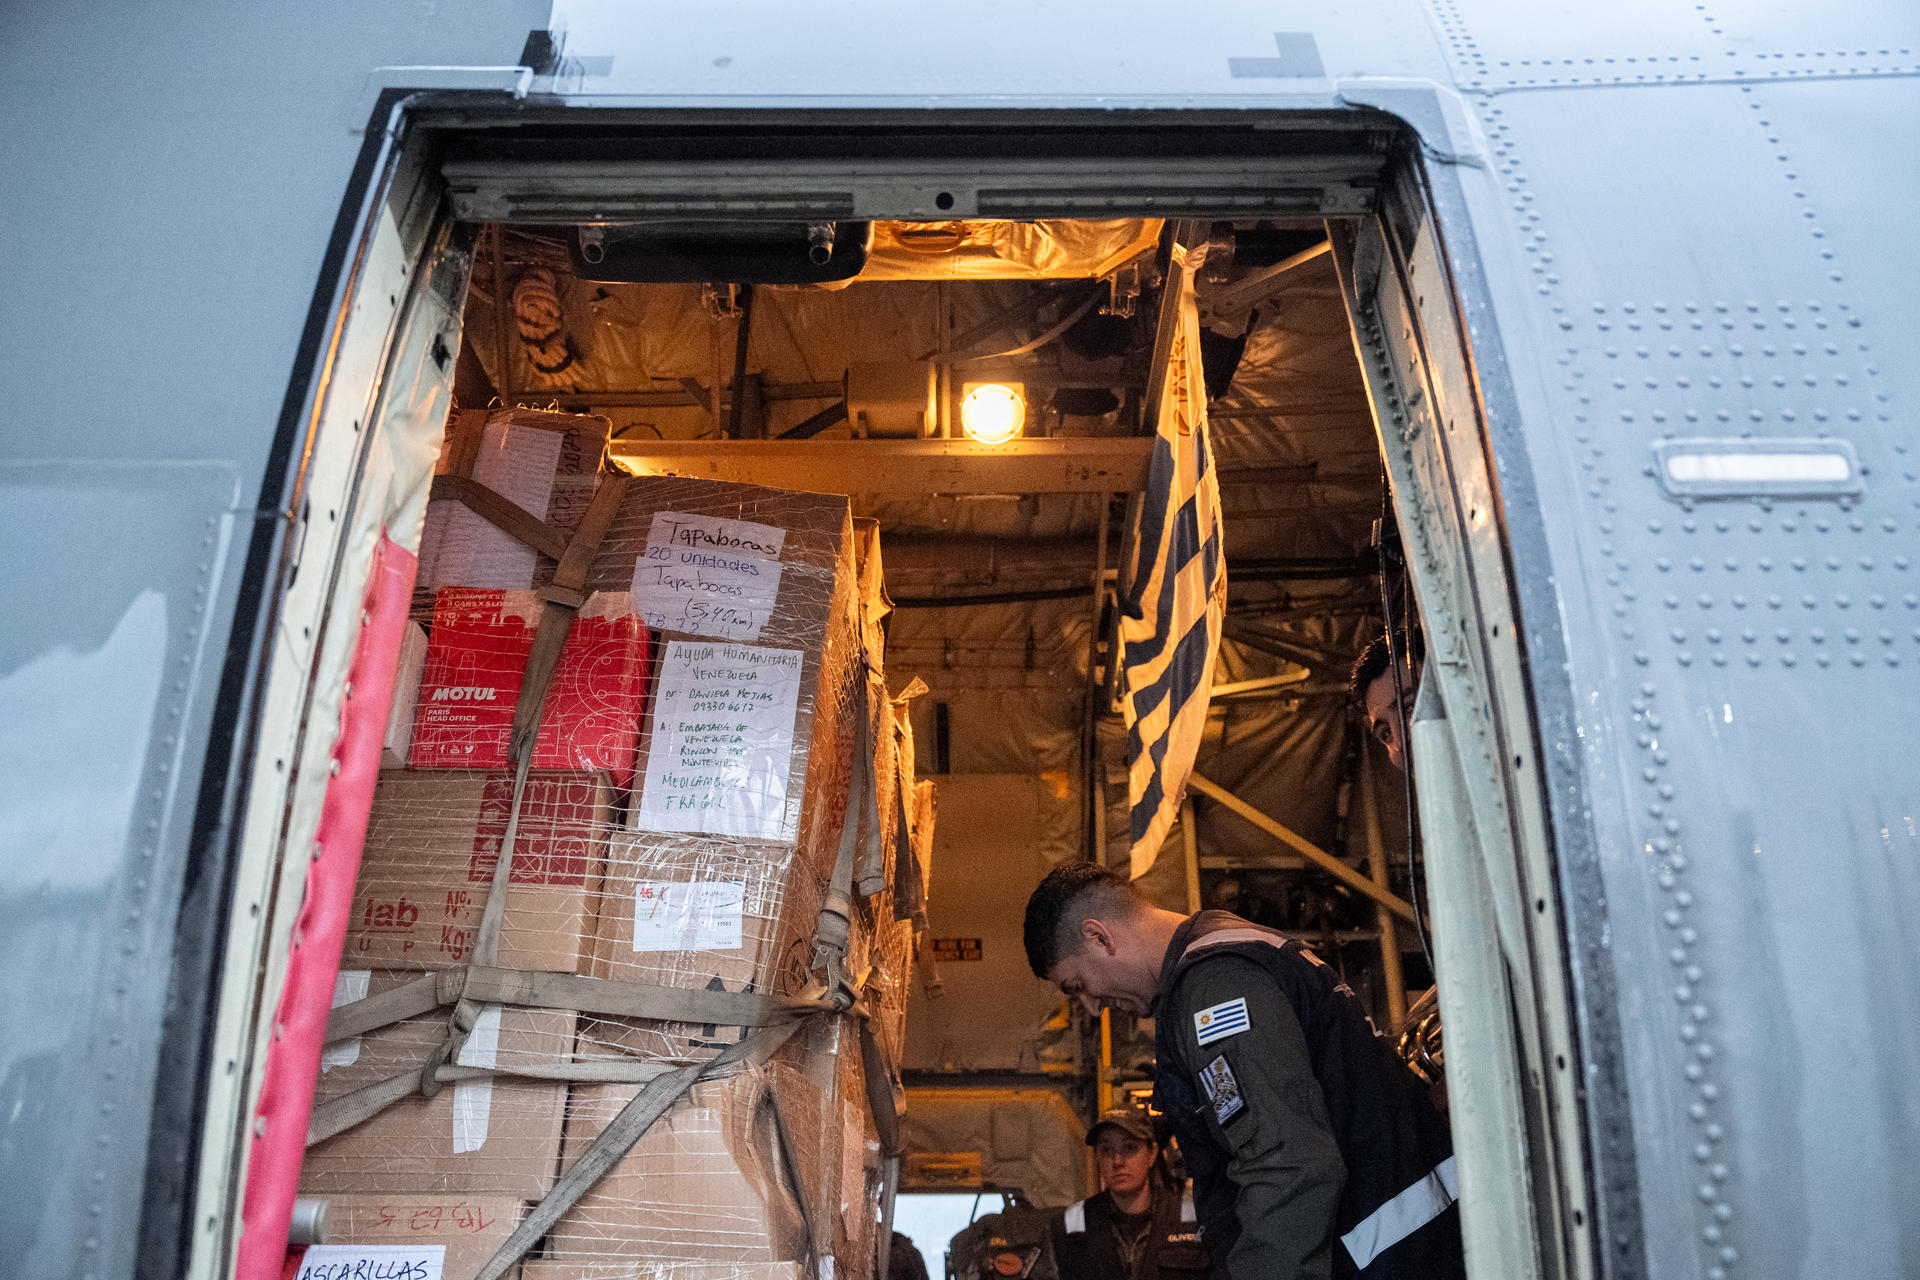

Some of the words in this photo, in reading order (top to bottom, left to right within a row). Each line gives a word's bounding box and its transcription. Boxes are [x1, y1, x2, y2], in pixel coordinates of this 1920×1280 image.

[661, 518, 777, 555] Tapabocas
[649, 547, 671, 560] 20
[681, 552, 759, 576] unidades
[431, 687, 497, 701] MOTUL
[364, 897, 419, 928] lab
[440, 924, 471, 961] Kg:
[295, 1258, 428, 1280] ASCARILLAS
